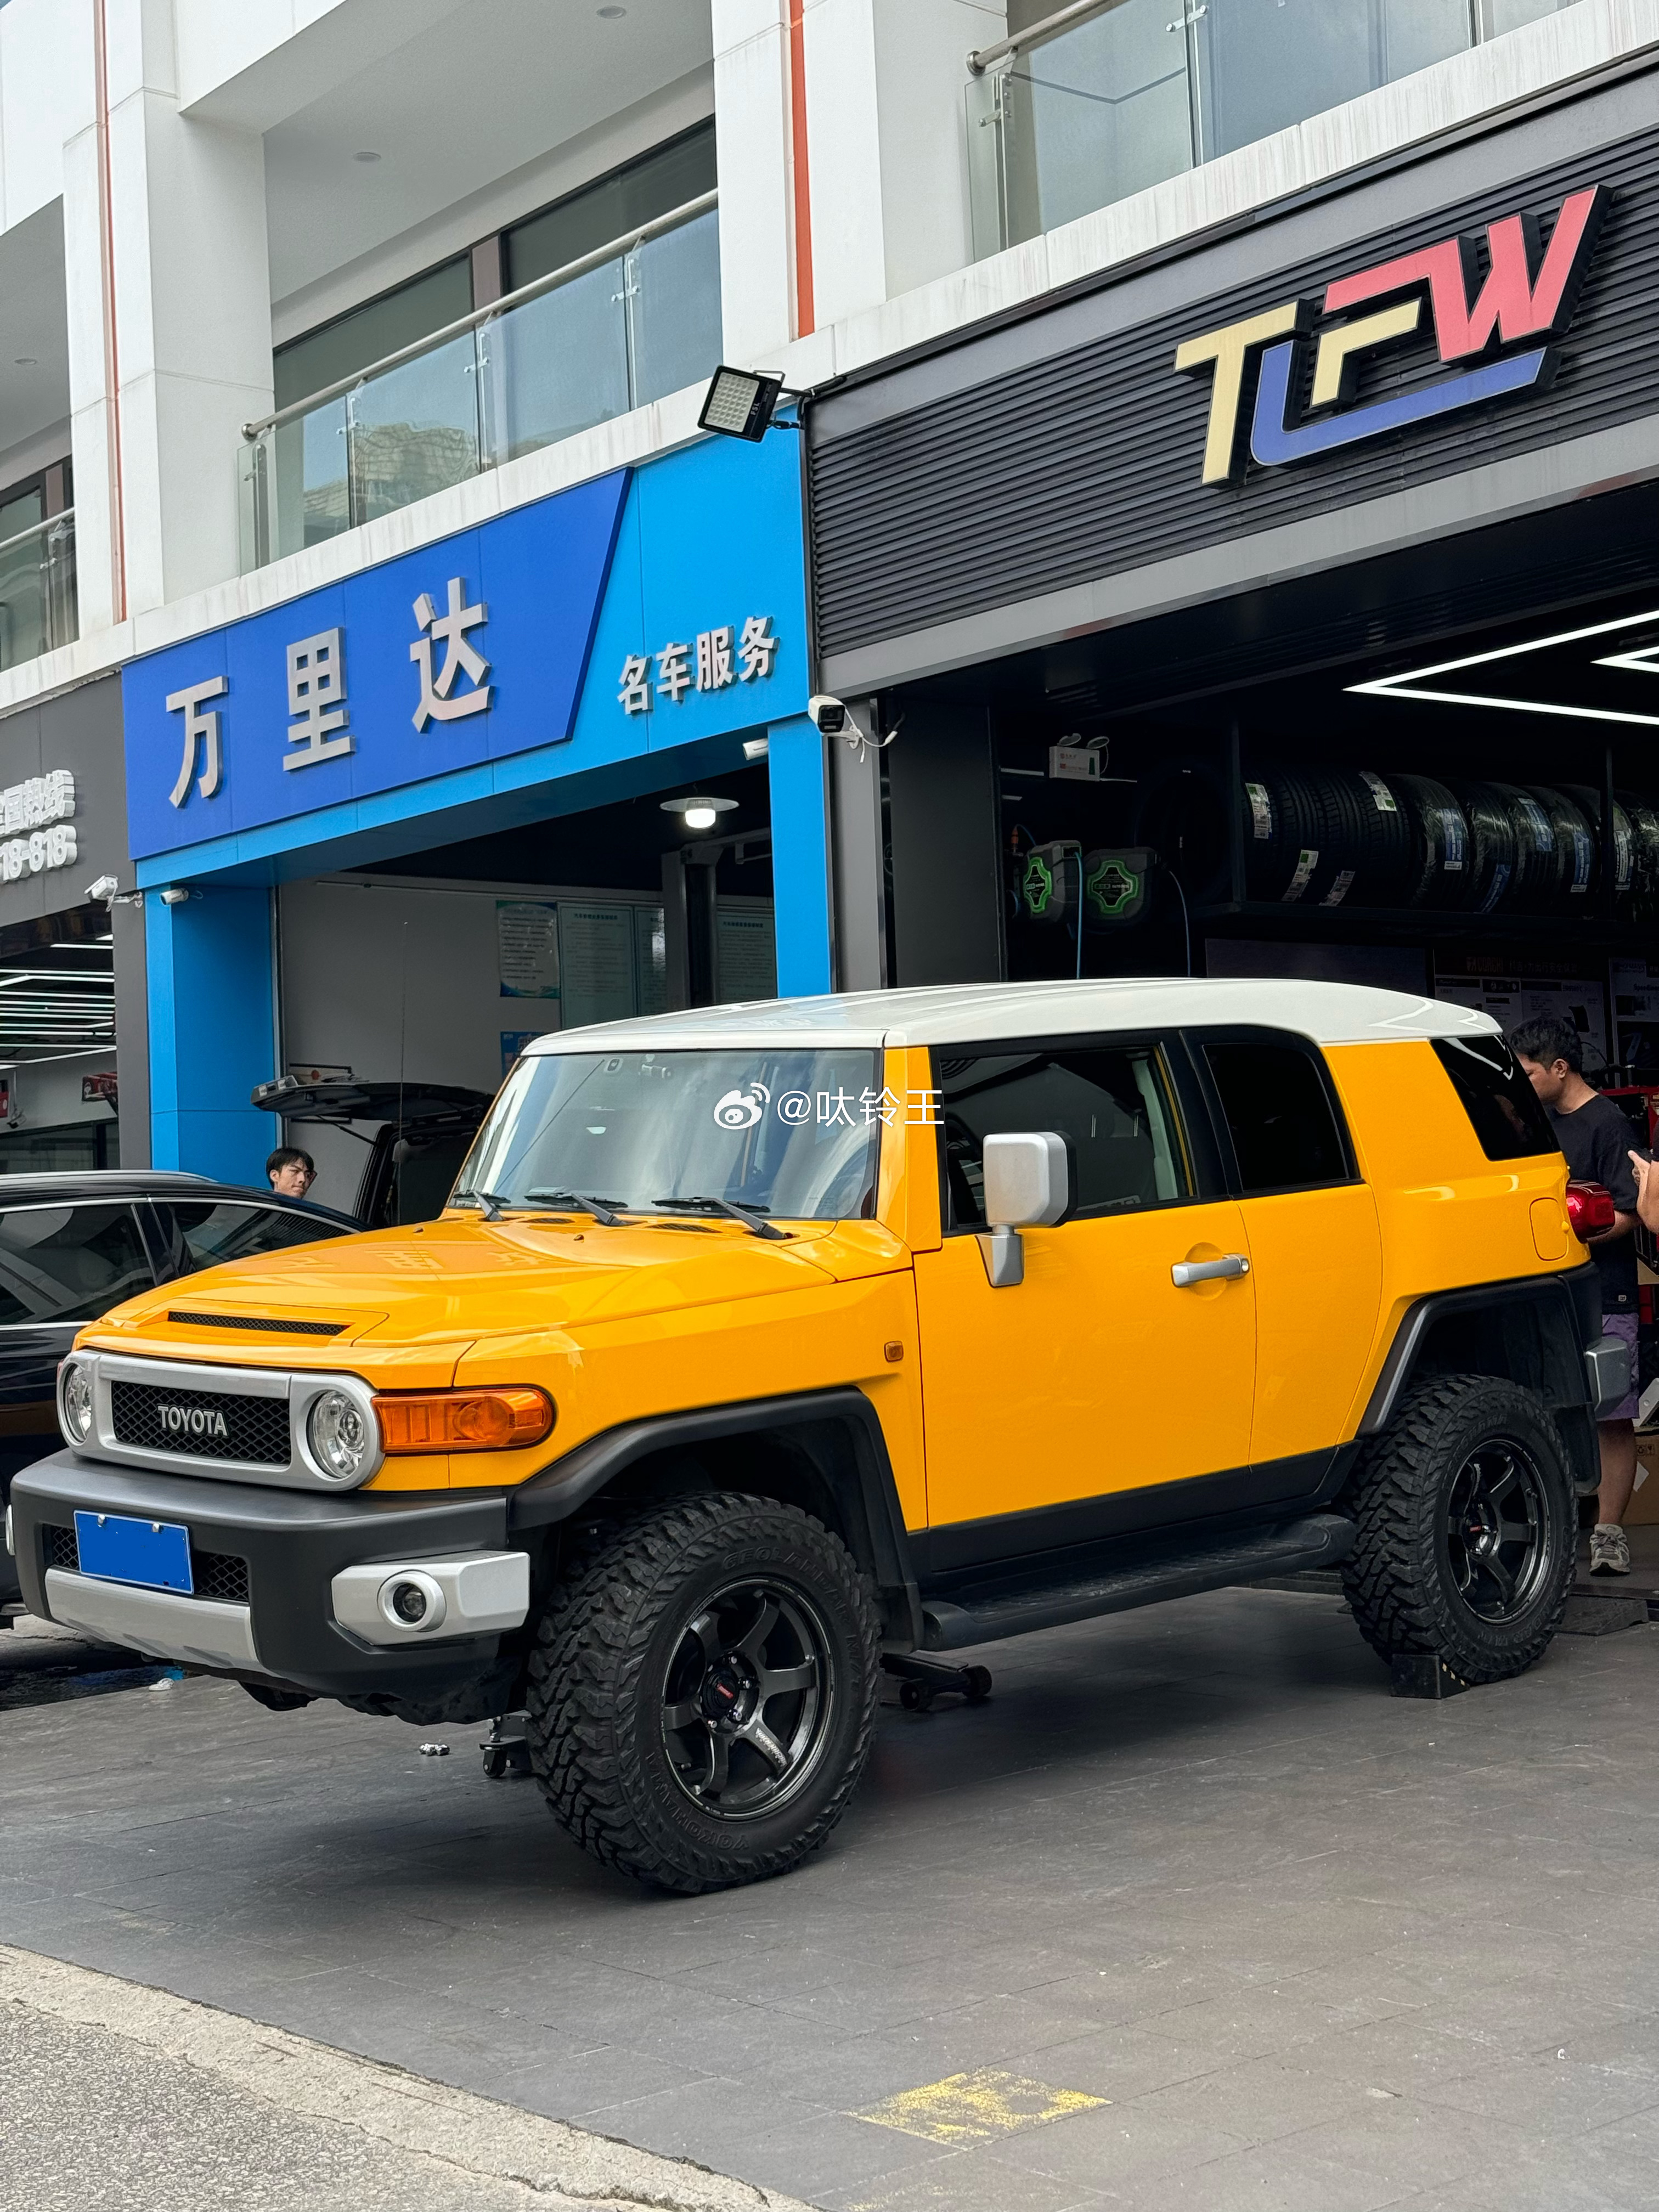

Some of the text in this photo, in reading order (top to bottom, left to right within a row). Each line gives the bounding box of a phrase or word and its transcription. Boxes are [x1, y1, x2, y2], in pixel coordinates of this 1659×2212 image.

[166, 577, 495, 809] 万里达
[617, 616, 780, 715] 名车服务
[157, 1404, 229, 1437] TOYOTA
[645, 1751, 750, 1850] YOKOHAMA
